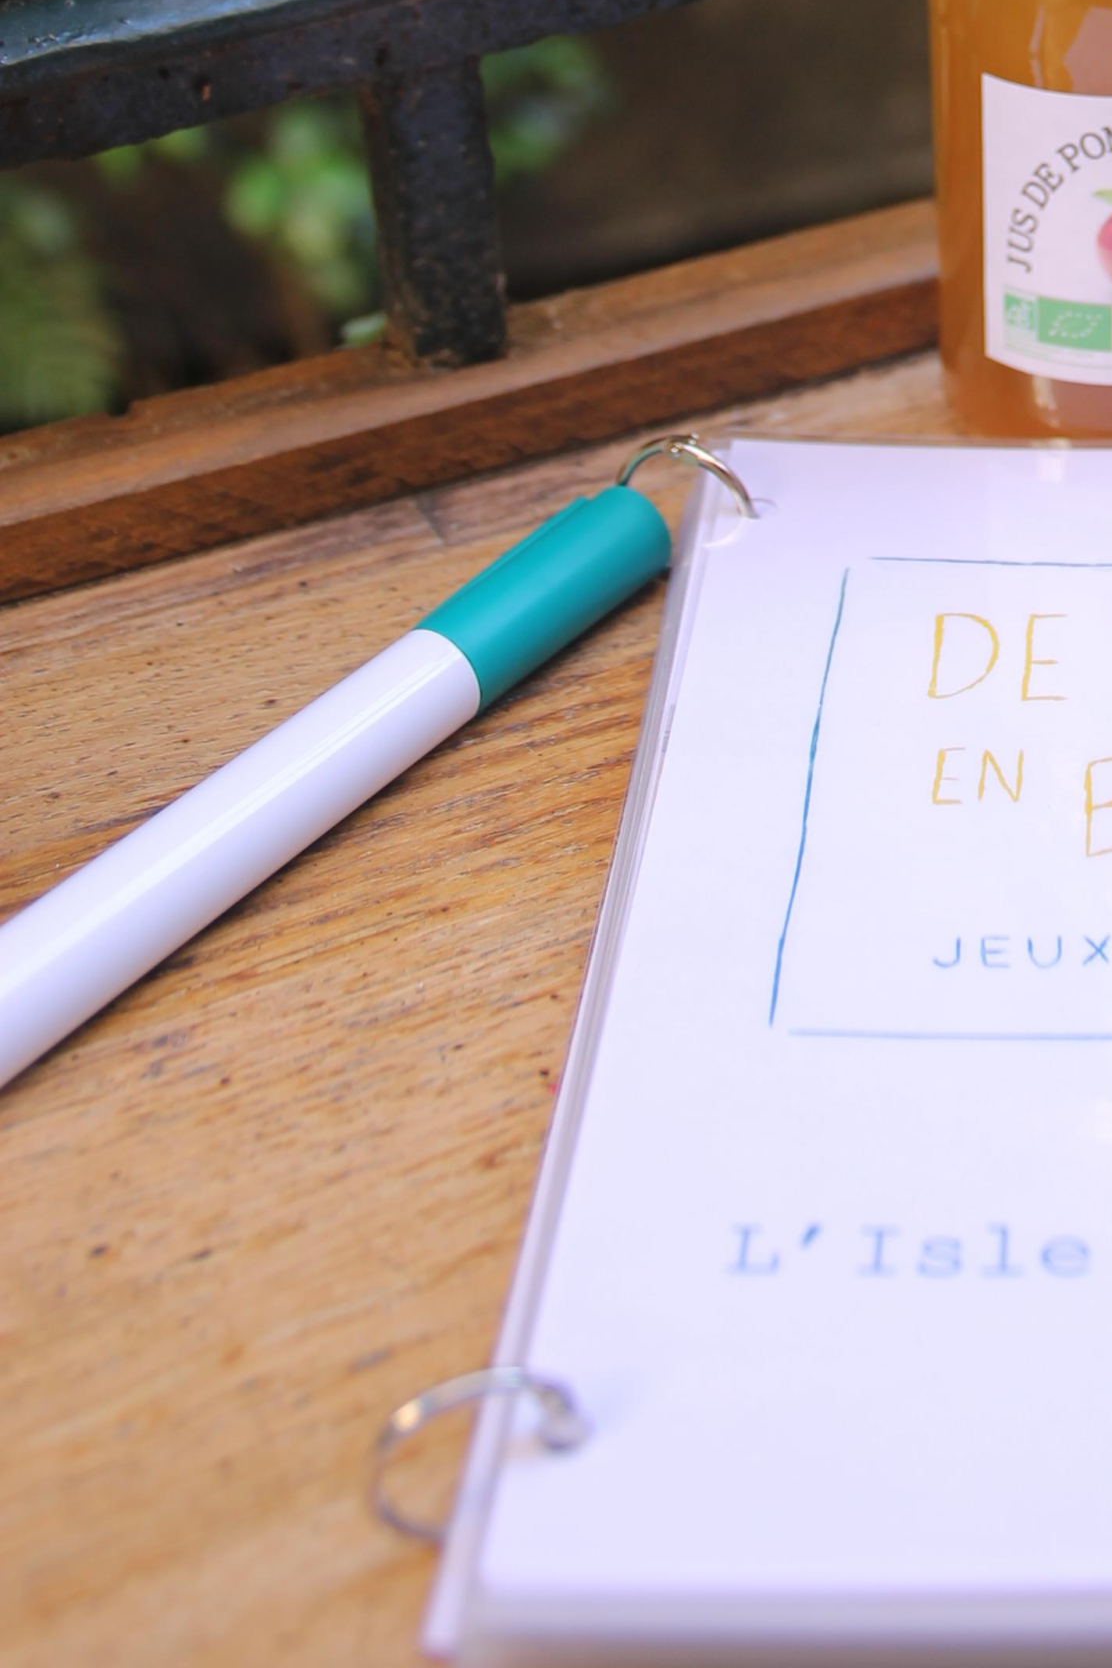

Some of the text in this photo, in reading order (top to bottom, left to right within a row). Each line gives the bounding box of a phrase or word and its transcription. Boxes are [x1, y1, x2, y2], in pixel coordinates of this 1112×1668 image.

[1021, 162, 1064, 210] DE
[1007, 208, 1038, 273] JUS
[926, 612, 1069, 701] DE
[931, 746, 1026, 805] EN
[931, 933, 1112, 969] JEUX
[724, 1219, 1094, 1280] L'Isle
